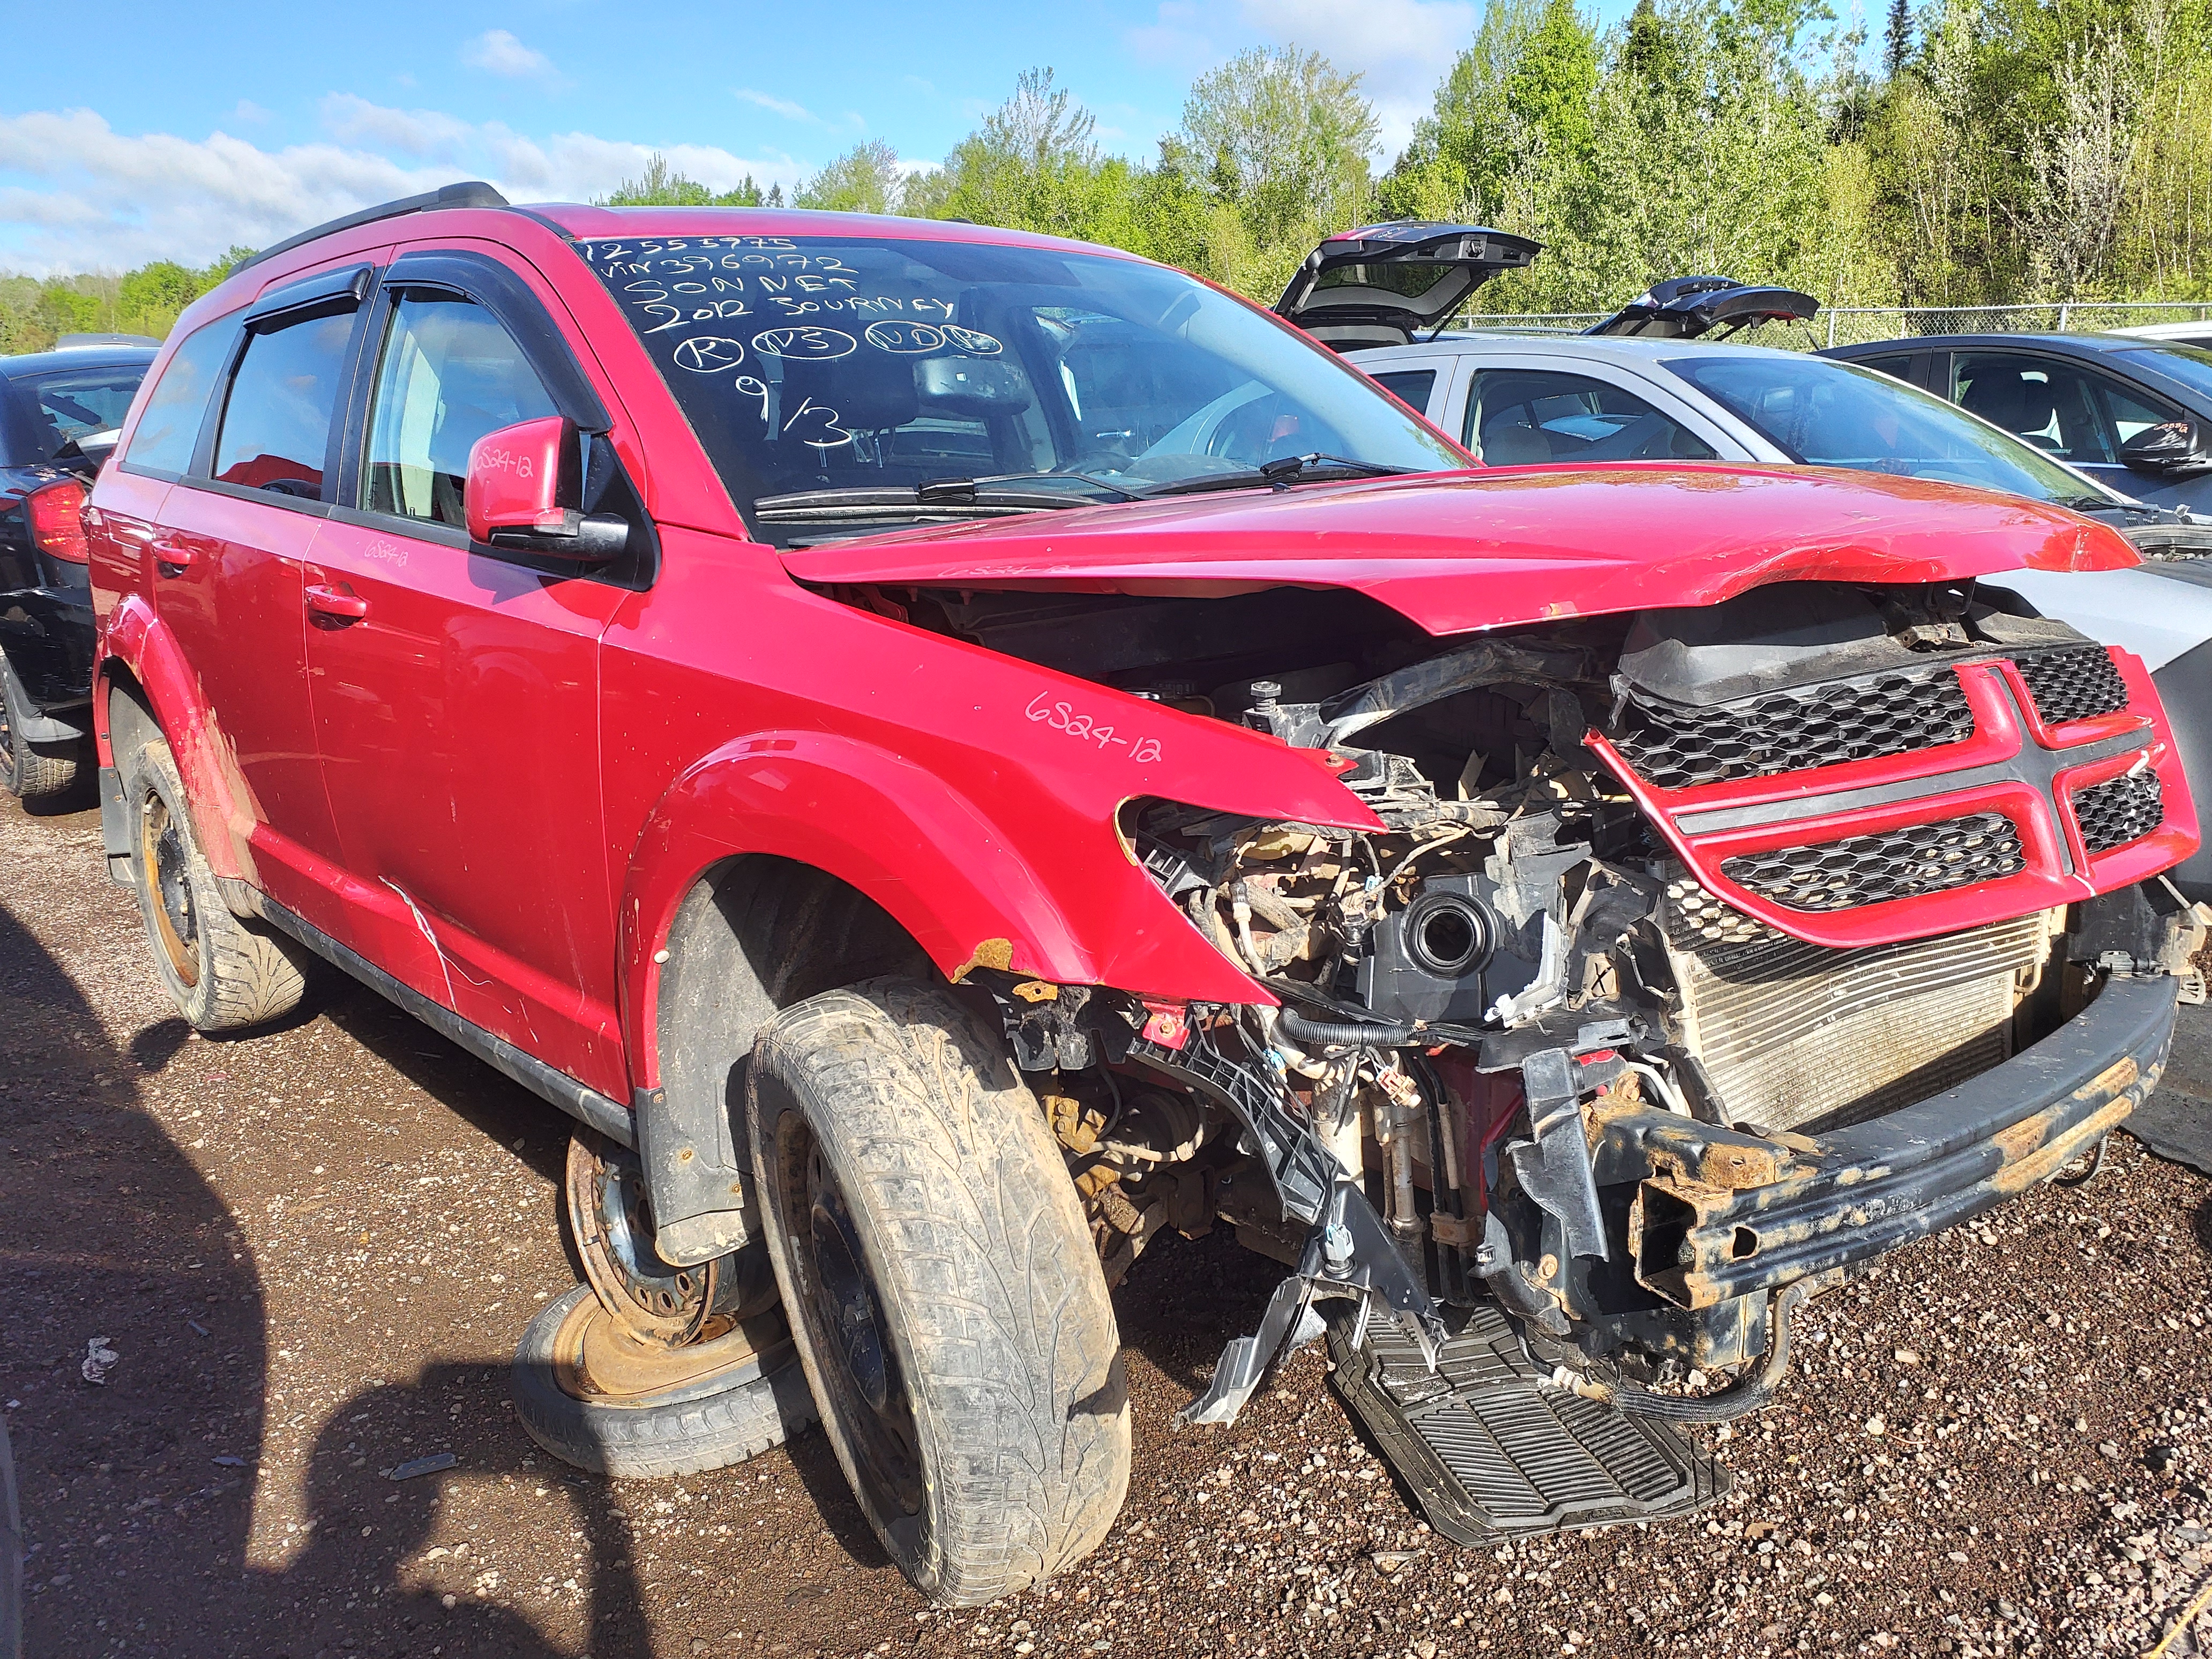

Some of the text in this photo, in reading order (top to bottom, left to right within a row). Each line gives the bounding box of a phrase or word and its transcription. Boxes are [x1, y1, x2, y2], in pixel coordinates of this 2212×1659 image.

[660, 253, 860, 275] 396972
[643, 300, 754, 334] 2012
[474, 446, 534, 478] 6S24-12
[1024, 690, 1162, 764] 6S24-12
